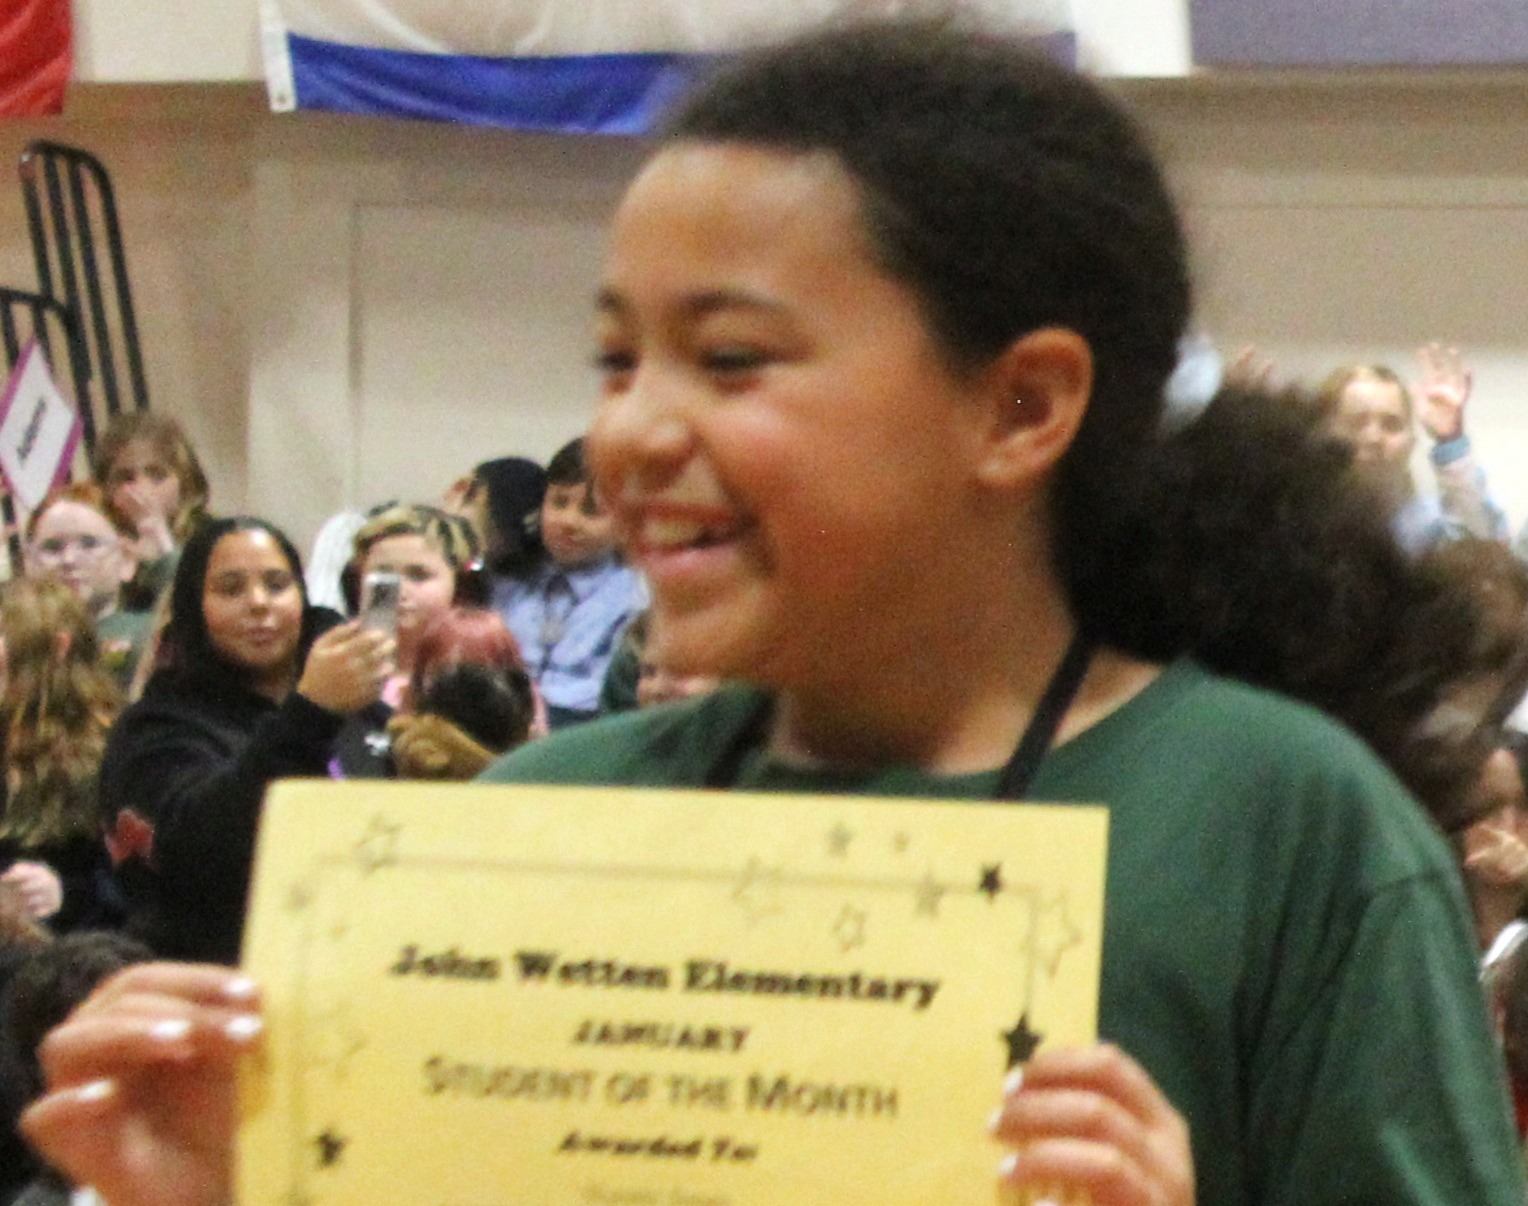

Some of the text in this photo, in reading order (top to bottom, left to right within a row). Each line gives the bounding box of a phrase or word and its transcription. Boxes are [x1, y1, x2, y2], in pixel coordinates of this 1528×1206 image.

[390, 944, 940, 1009] John Wetten Elementary
[573, 1019, 750, 1053] JANUARY
